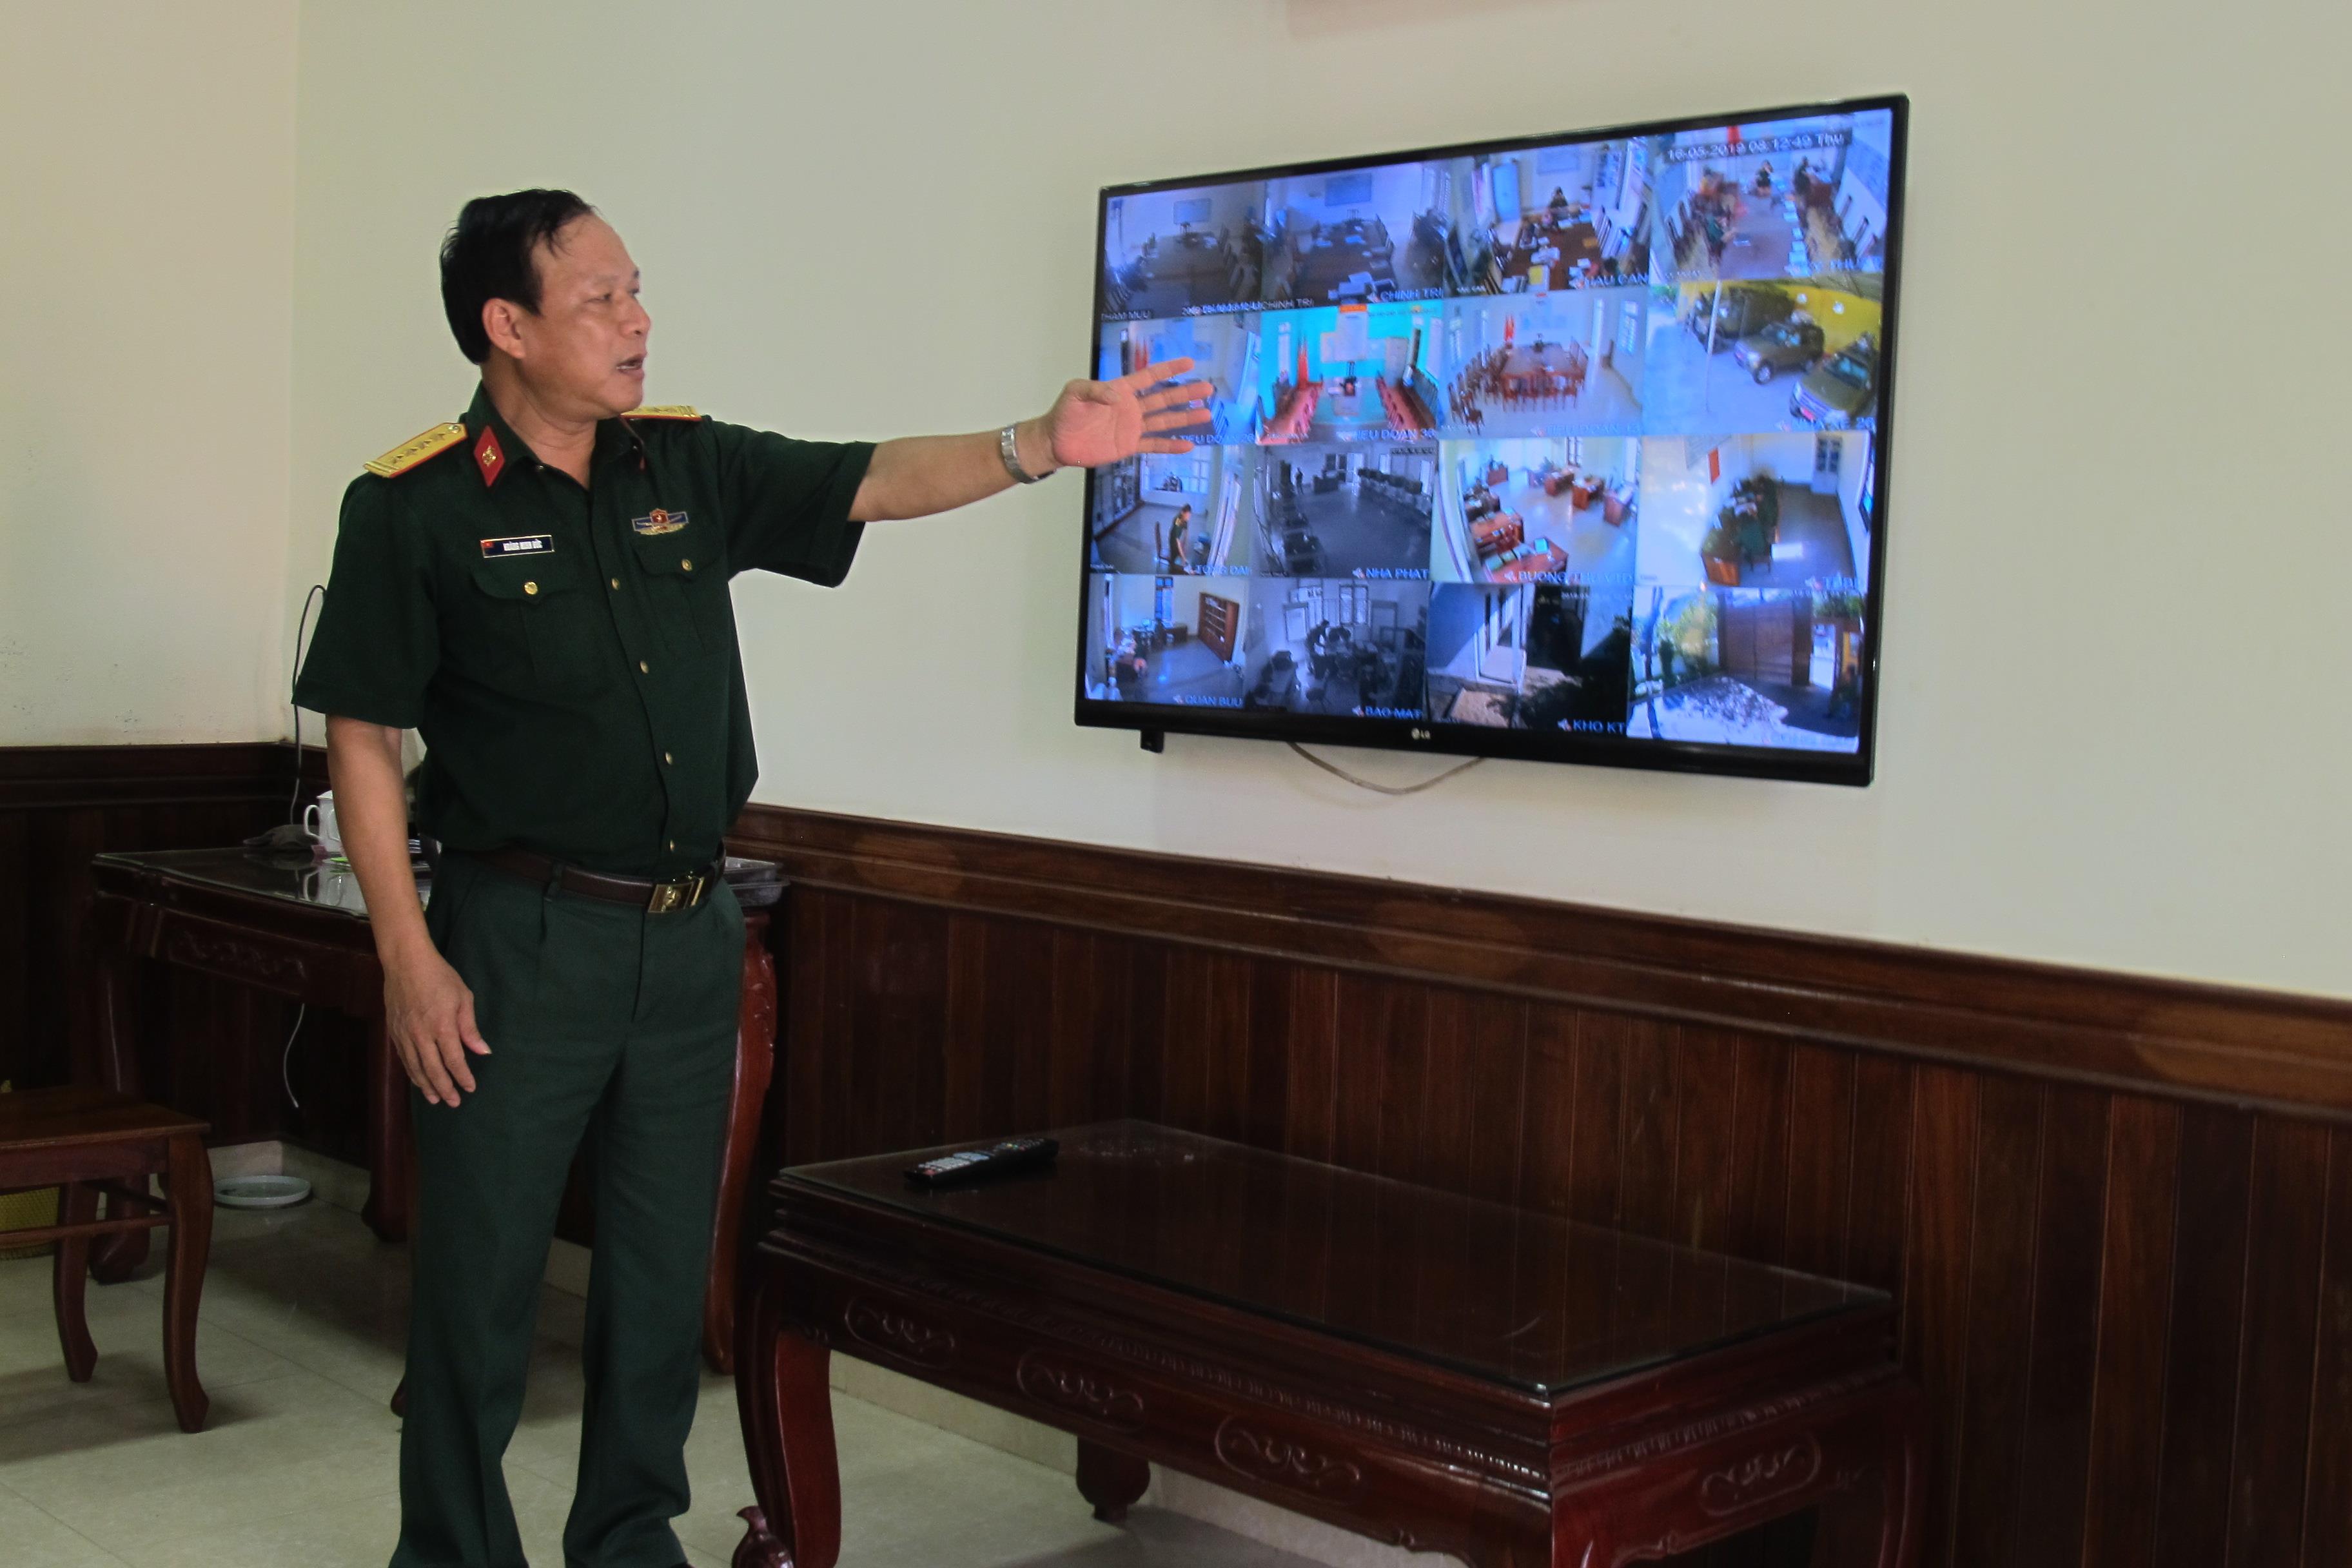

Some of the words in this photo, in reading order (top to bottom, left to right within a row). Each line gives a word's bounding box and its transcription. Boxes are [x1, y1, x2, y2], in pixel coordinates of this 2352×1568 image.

[1366, 568, 1393, 579] NHA
[1395, 568, 1429, 580] PHAT
[1573, 719, 1603, 732] KHO
